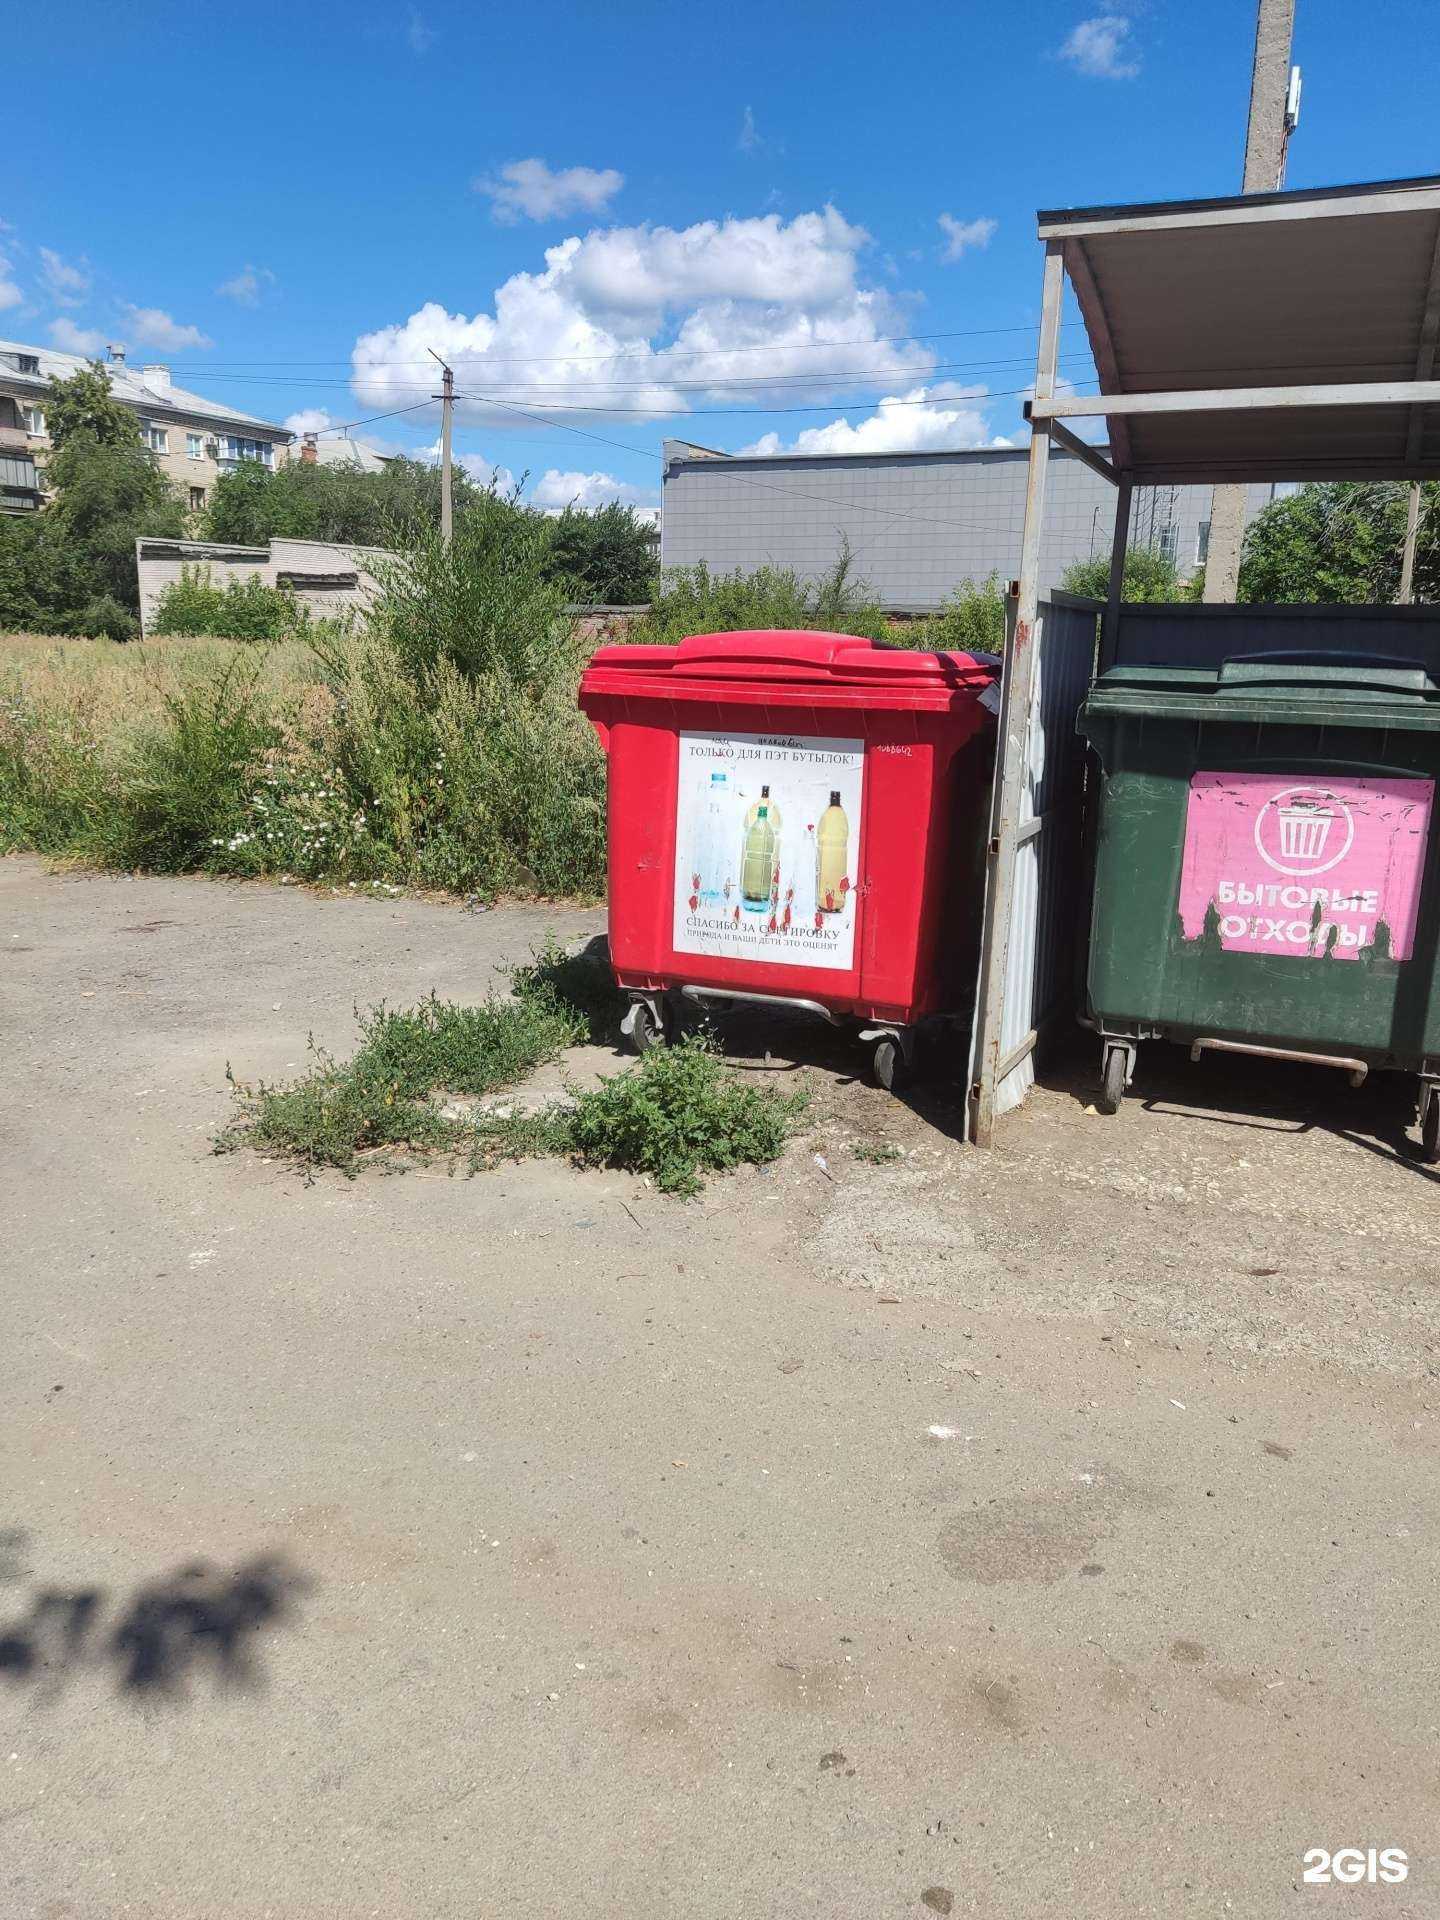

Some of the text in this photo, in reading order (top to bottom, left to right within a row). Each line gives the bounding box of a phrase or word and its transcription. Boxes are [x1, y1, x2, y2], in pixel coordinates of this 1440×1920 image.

[688, 746, 854, 765] ТОЛЬКО ДЛЯ ПЭТ БУТЫЛОК!
[1218, 880, 1379, 913] БЫТОВЫЕ
[686, 916, 738, 931] СПАСИБО
[742, 923, 755, 934] ЗА
[687, 929, 838, 950] ПРИРОДА И ВАШИ ДЕТИ ЭТО ОЦЕНЯТ
